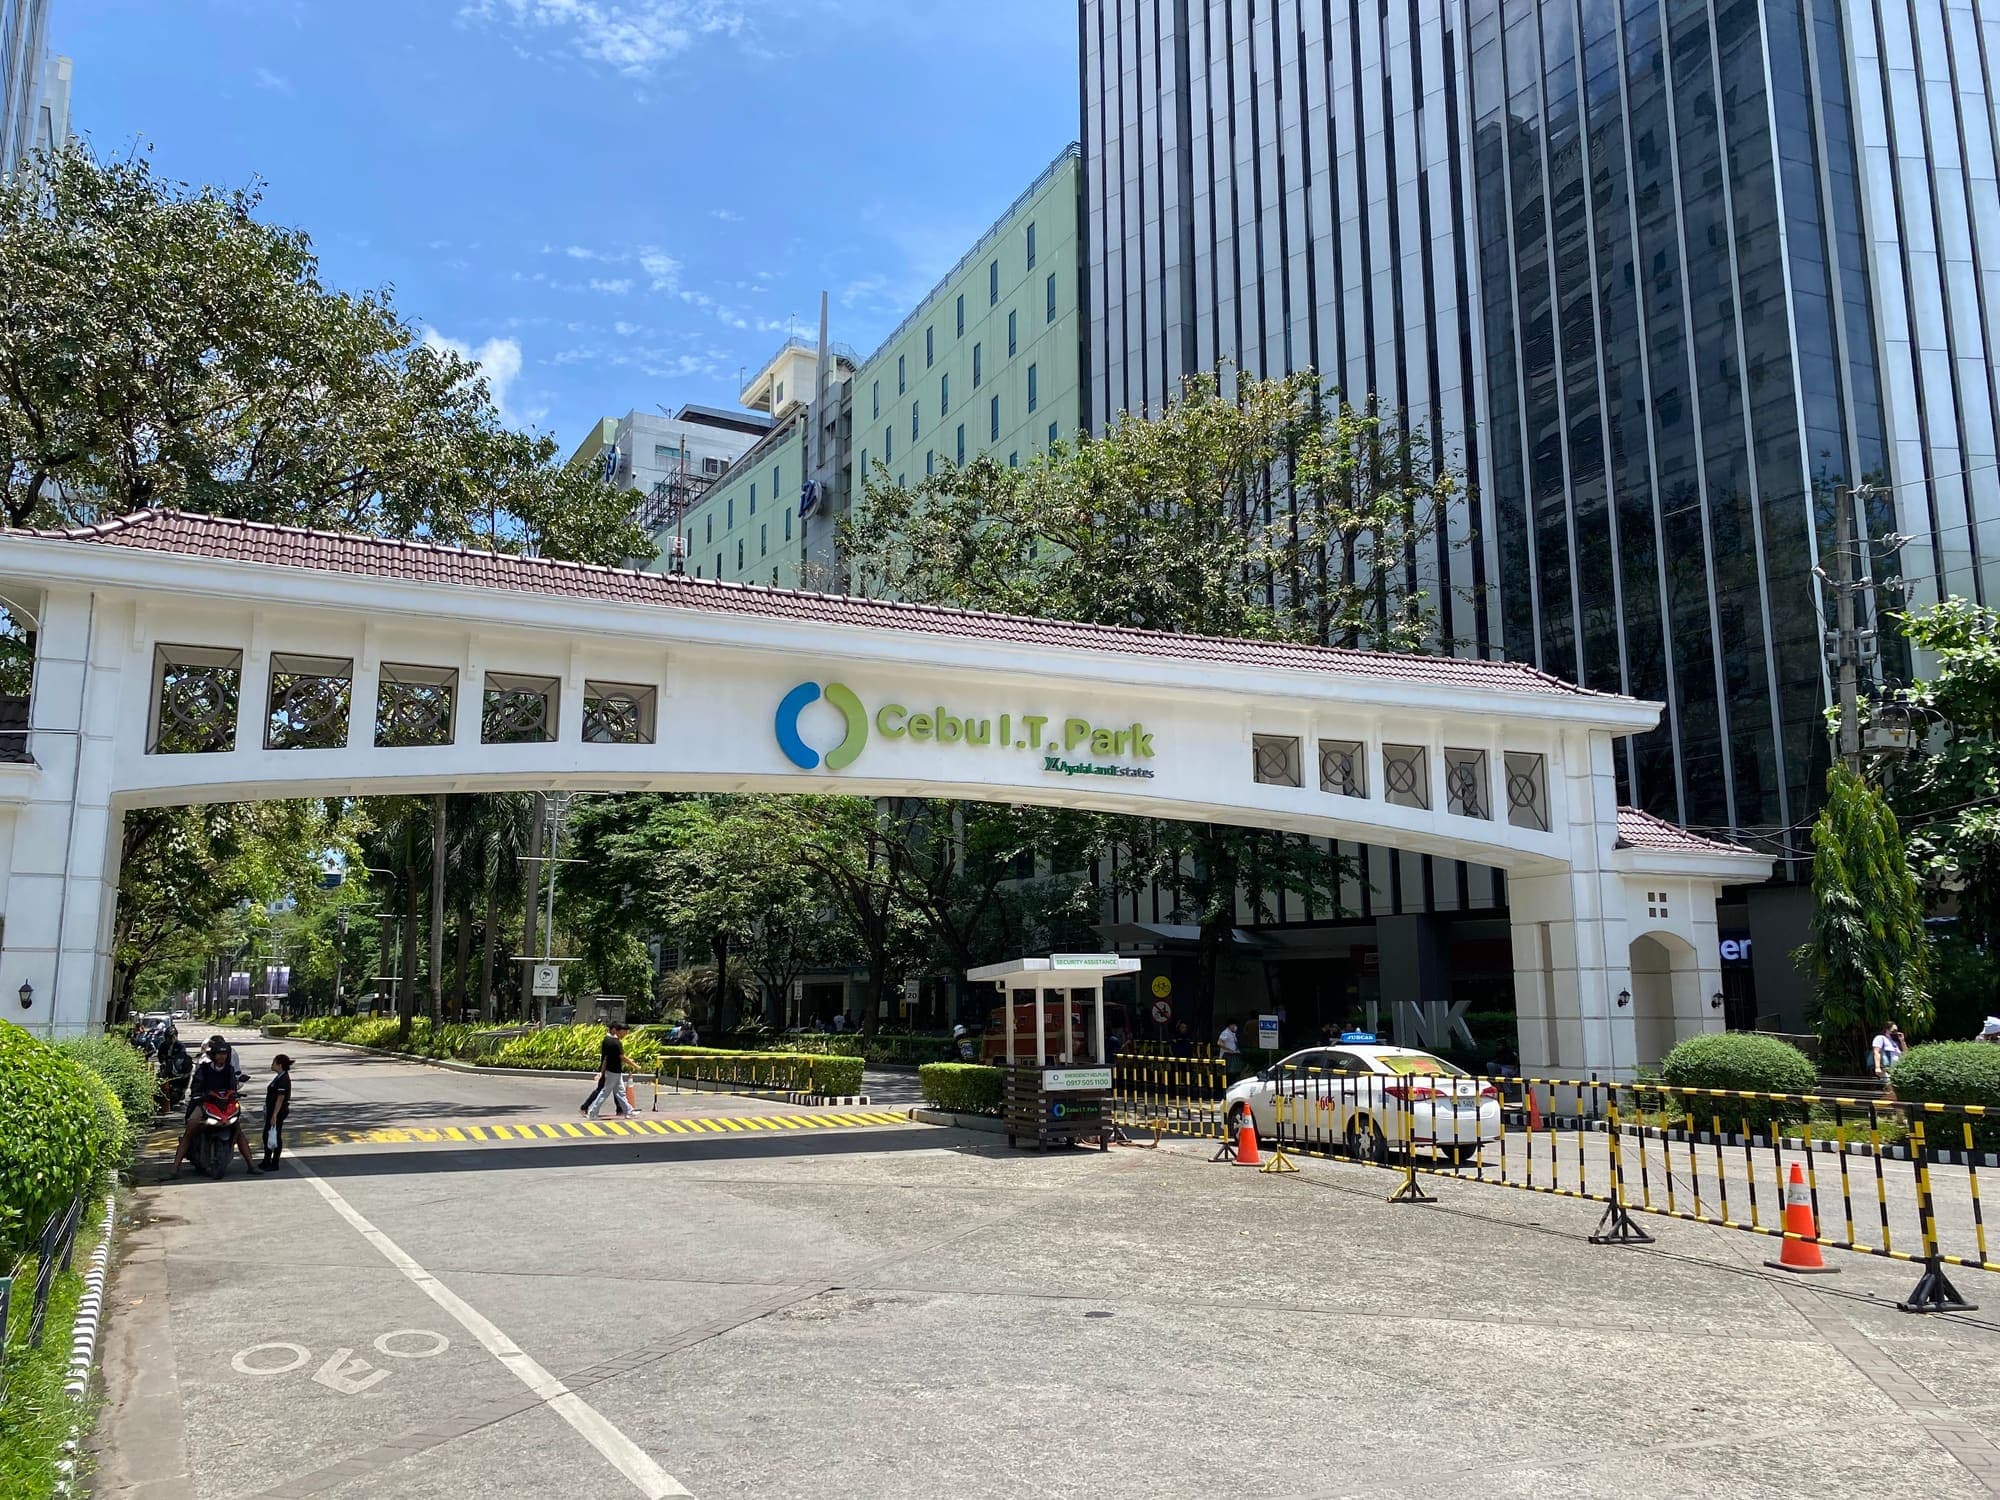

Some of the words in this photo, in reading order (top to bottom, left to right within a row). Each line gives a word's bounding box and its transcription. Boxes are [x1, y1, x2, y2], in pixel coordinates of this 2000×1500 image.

[876, 703, 991, 745] Cebu
[1000, 713, 1059, 751] I.T.
[1064, 718, 1156, 758] Park
[1095, 1078, 1109, 1086] 1100
